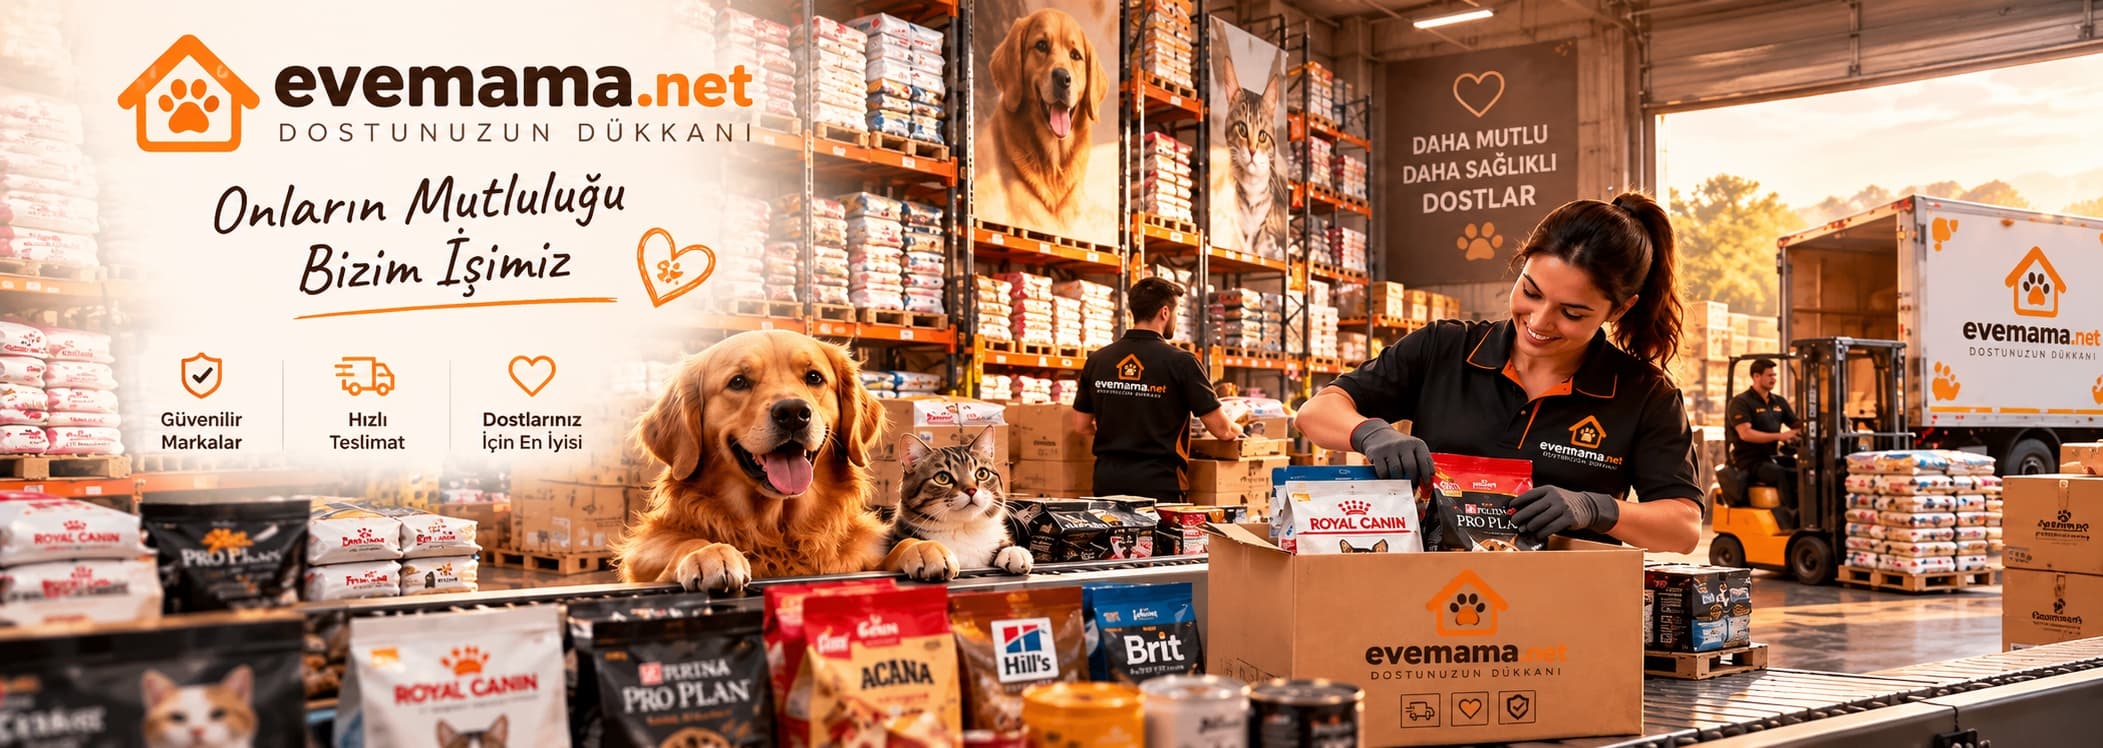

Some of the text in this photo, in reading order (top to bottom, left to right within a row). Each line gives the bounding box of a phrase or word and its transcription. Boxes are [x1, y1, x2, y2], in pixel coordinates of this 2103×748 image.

[1412, 124, 1548, 155] DAHA MUTLU
[1403, 152, 1557, 184] DAHA SAĞLIKLI
[1423, 184, 1537, 214] DOSTLAR
[1963, 320, 2101, 347] evemama.net
[1969, 346, 2096, 361] DOSTUNUZUN DÜKKANI
[1095, 380, 1166, 393] evemama.net
[1540, 441, 1623, 465] evemama.net
[1310, 516, 1406, 529] ROYAL CANIN
[1457, 514, 1518, 529] PRO PLA
[34, 532, 120, 544] ROYAL CANIN
[181, 548, 225, 567] PRO
[1123, 631, 1185, 665] Brit
[1365, 643, 1568, 665] evemama.net
[861, 659, 934, 690] ACANA
[1004, 654, 1051, 675] Hill's
[1370, 666, 1561, 680] DOSTUNUZUN DÜKKANI
[394, 673, 538, 704] ROYAL CANIN
[622, 679, 751, 713] PRO PLAN
